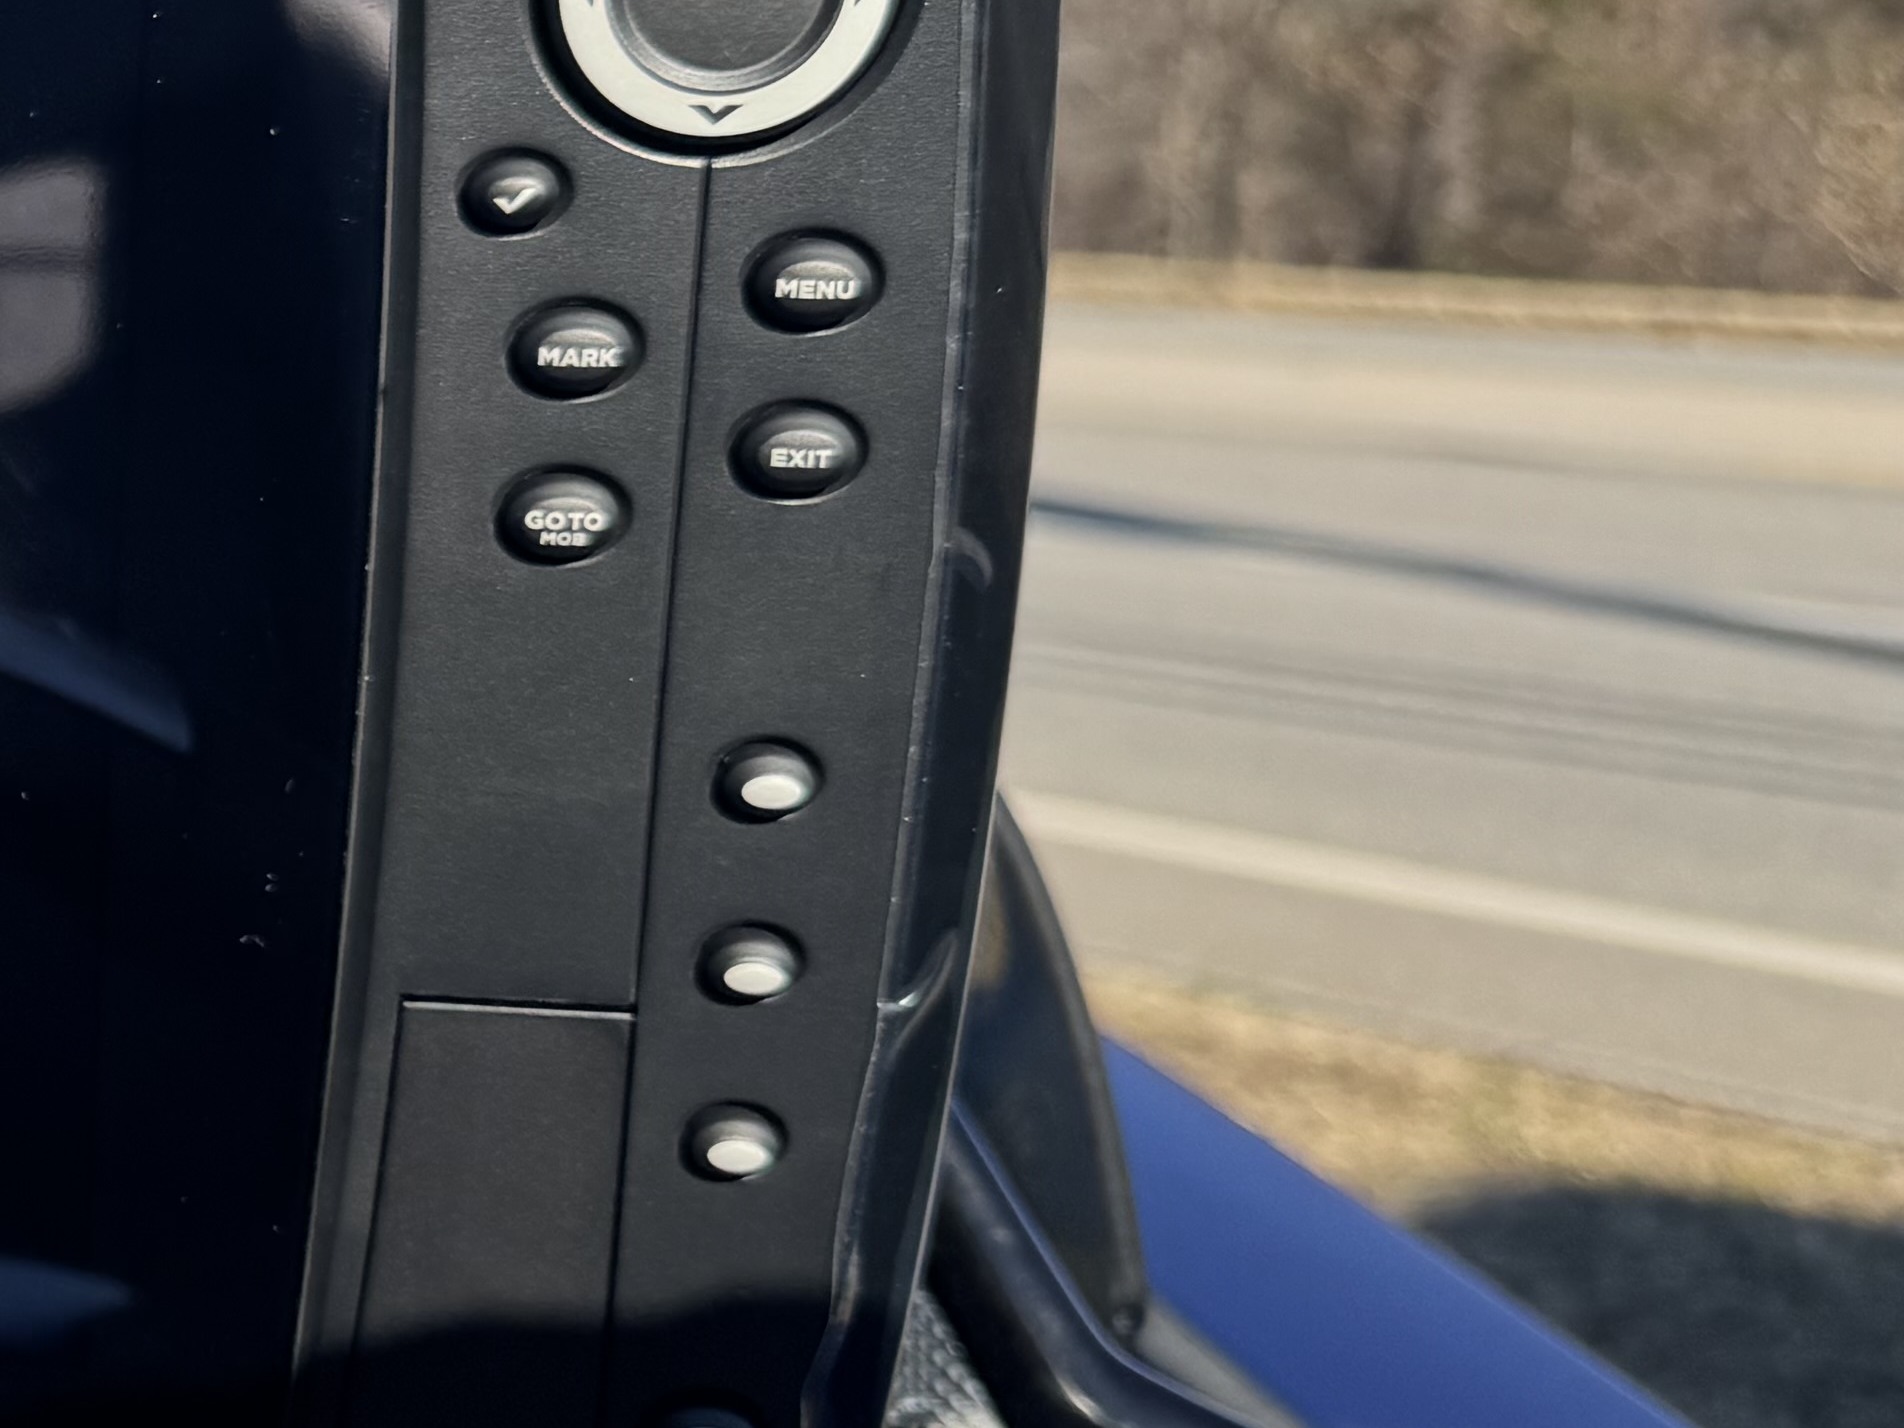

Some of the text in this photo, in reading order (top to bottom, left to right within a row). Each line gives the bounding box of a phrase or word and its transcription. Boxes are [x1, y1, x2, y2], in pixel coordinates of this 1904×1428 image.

[775, 277, 858, 300] MENU
[537, 346, 621, 368] MARK
[770, 448, 833, 469] EXIT
[539, 531, 588, 547] MOB
